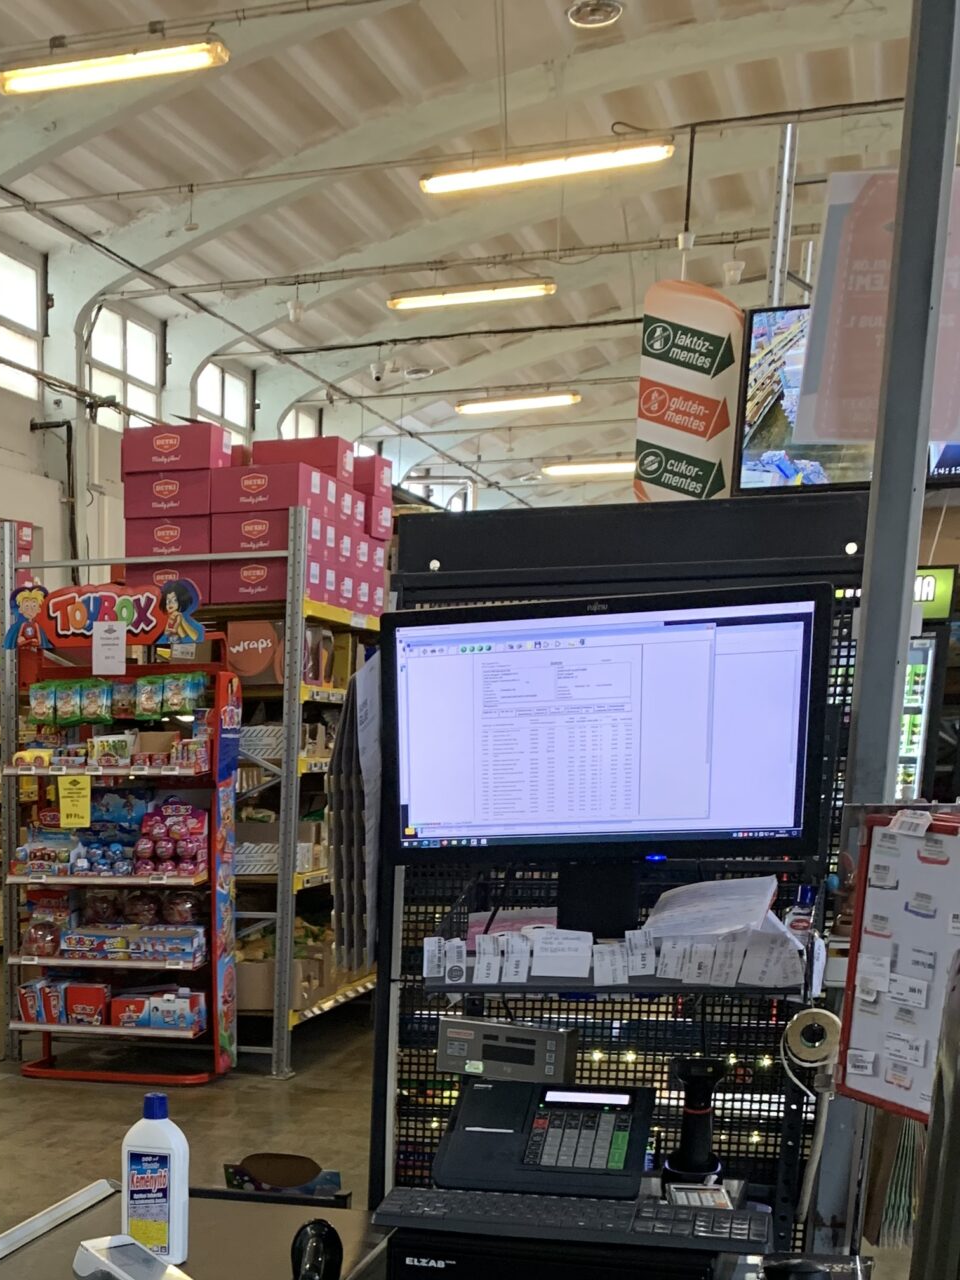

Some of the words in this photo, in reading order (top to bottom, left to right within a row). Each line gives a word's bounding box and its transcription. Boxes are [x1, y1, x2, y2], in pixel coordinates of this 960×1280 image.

[673, 328, 714, 352] laktóz-
[668, 346, 713, 369] mentes
[669, 396, 709, 417] glutén-
[664, 409, 706, 432] mentes
[666, 457, 704, 478] cukor-
[661, 471, 703, 495] mentes
[49, 590, 158, 635] TOYBOX
[230, 636, 273, 655] wraps
[405, 1255, 446, 1269] ELZAB
